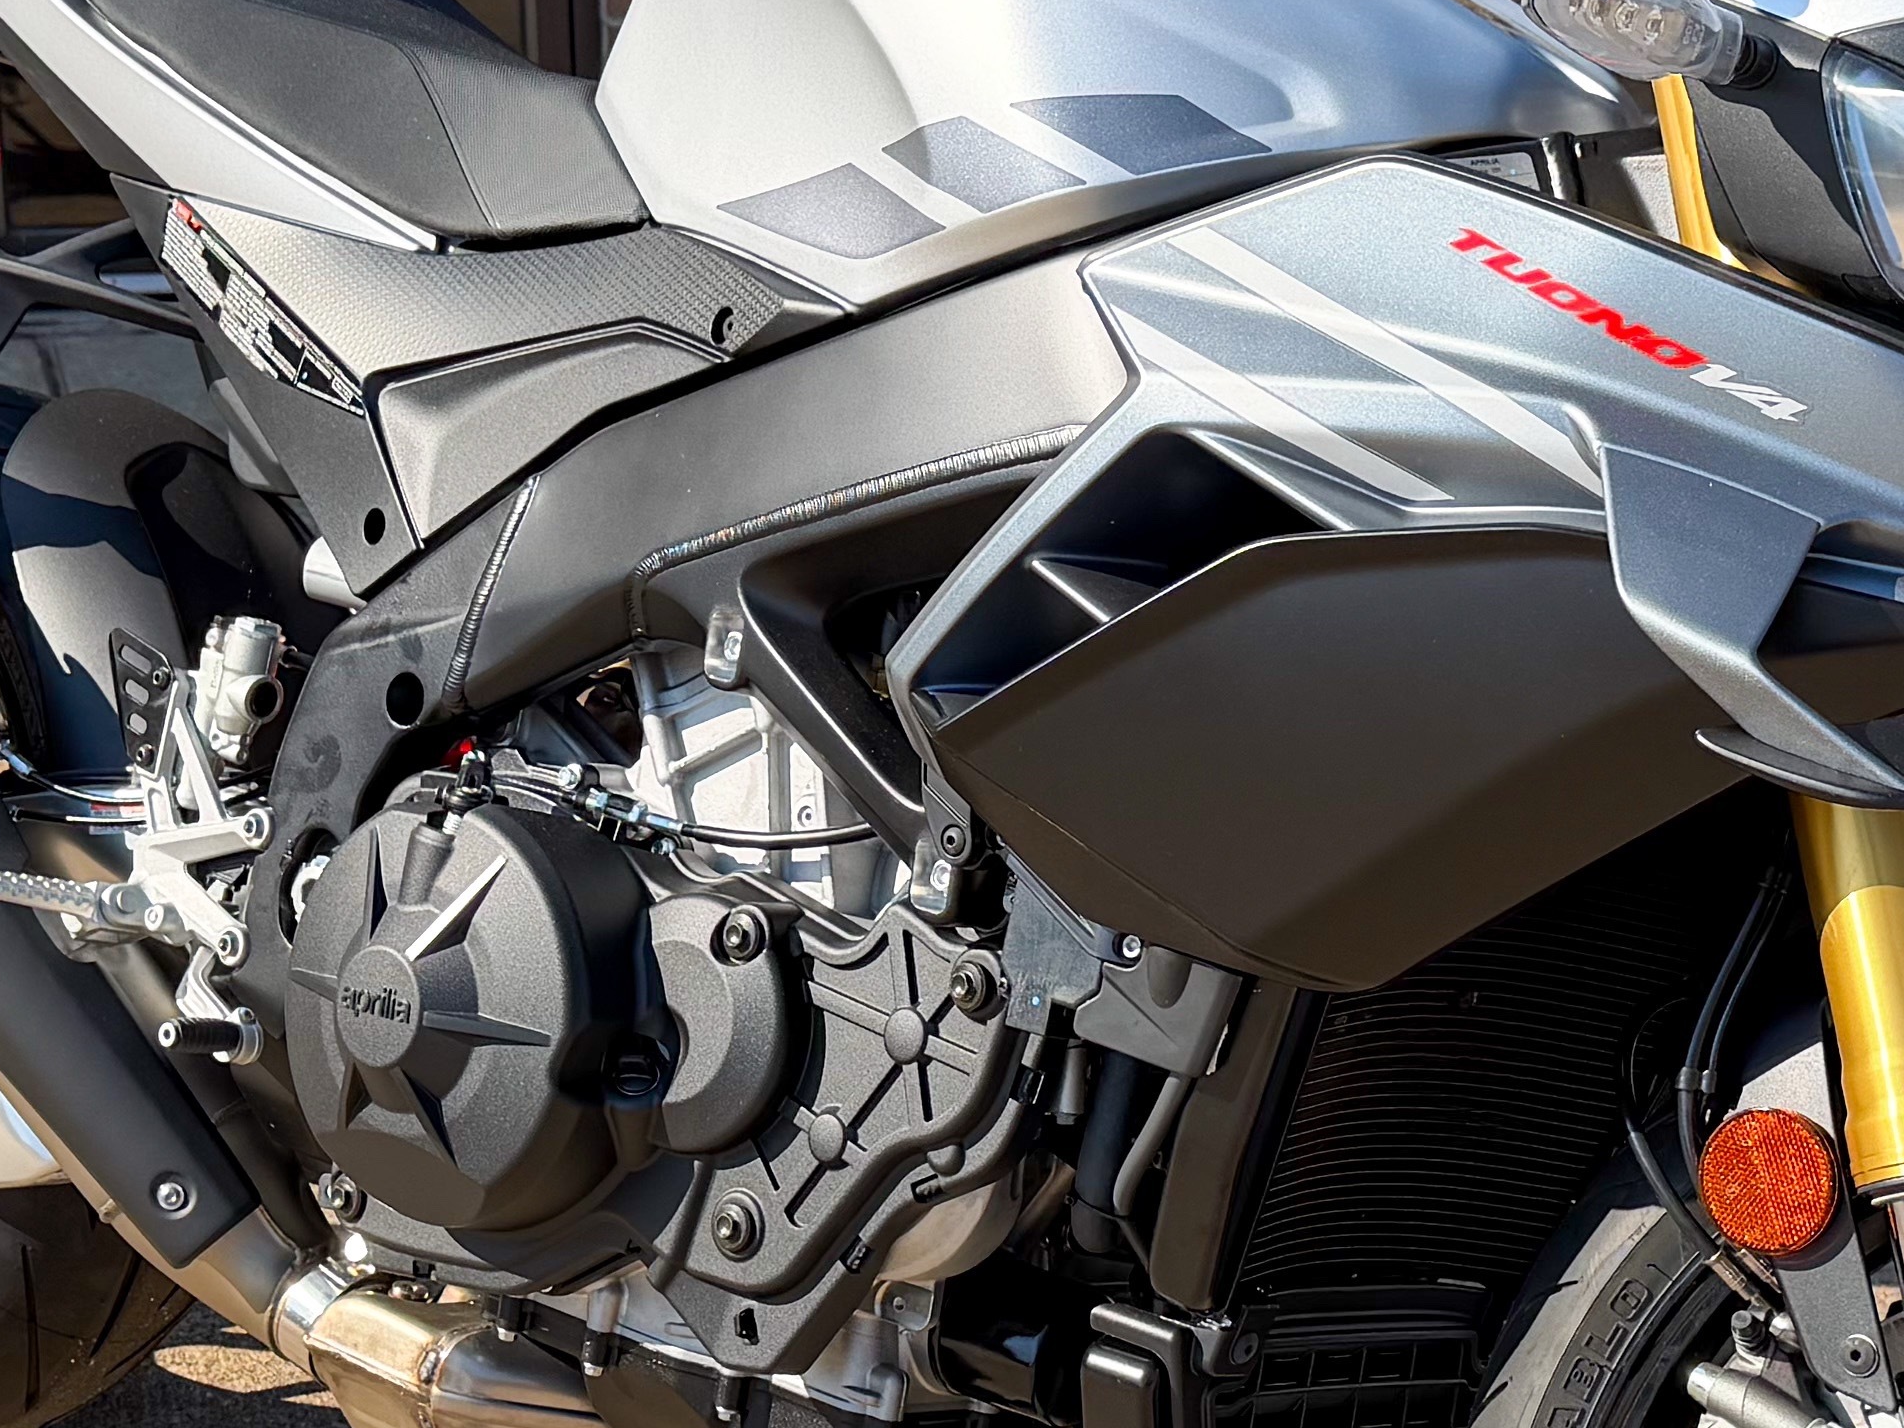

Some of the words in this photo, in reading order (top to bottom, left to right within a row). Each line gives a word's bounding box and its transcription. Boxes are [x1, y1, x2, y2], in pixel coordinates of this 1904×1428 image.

[1448, 227, 1709, 370] TUONO
[1689, 362, 1809, 422] V4
[341, 986, 412, 1024] aprilia
